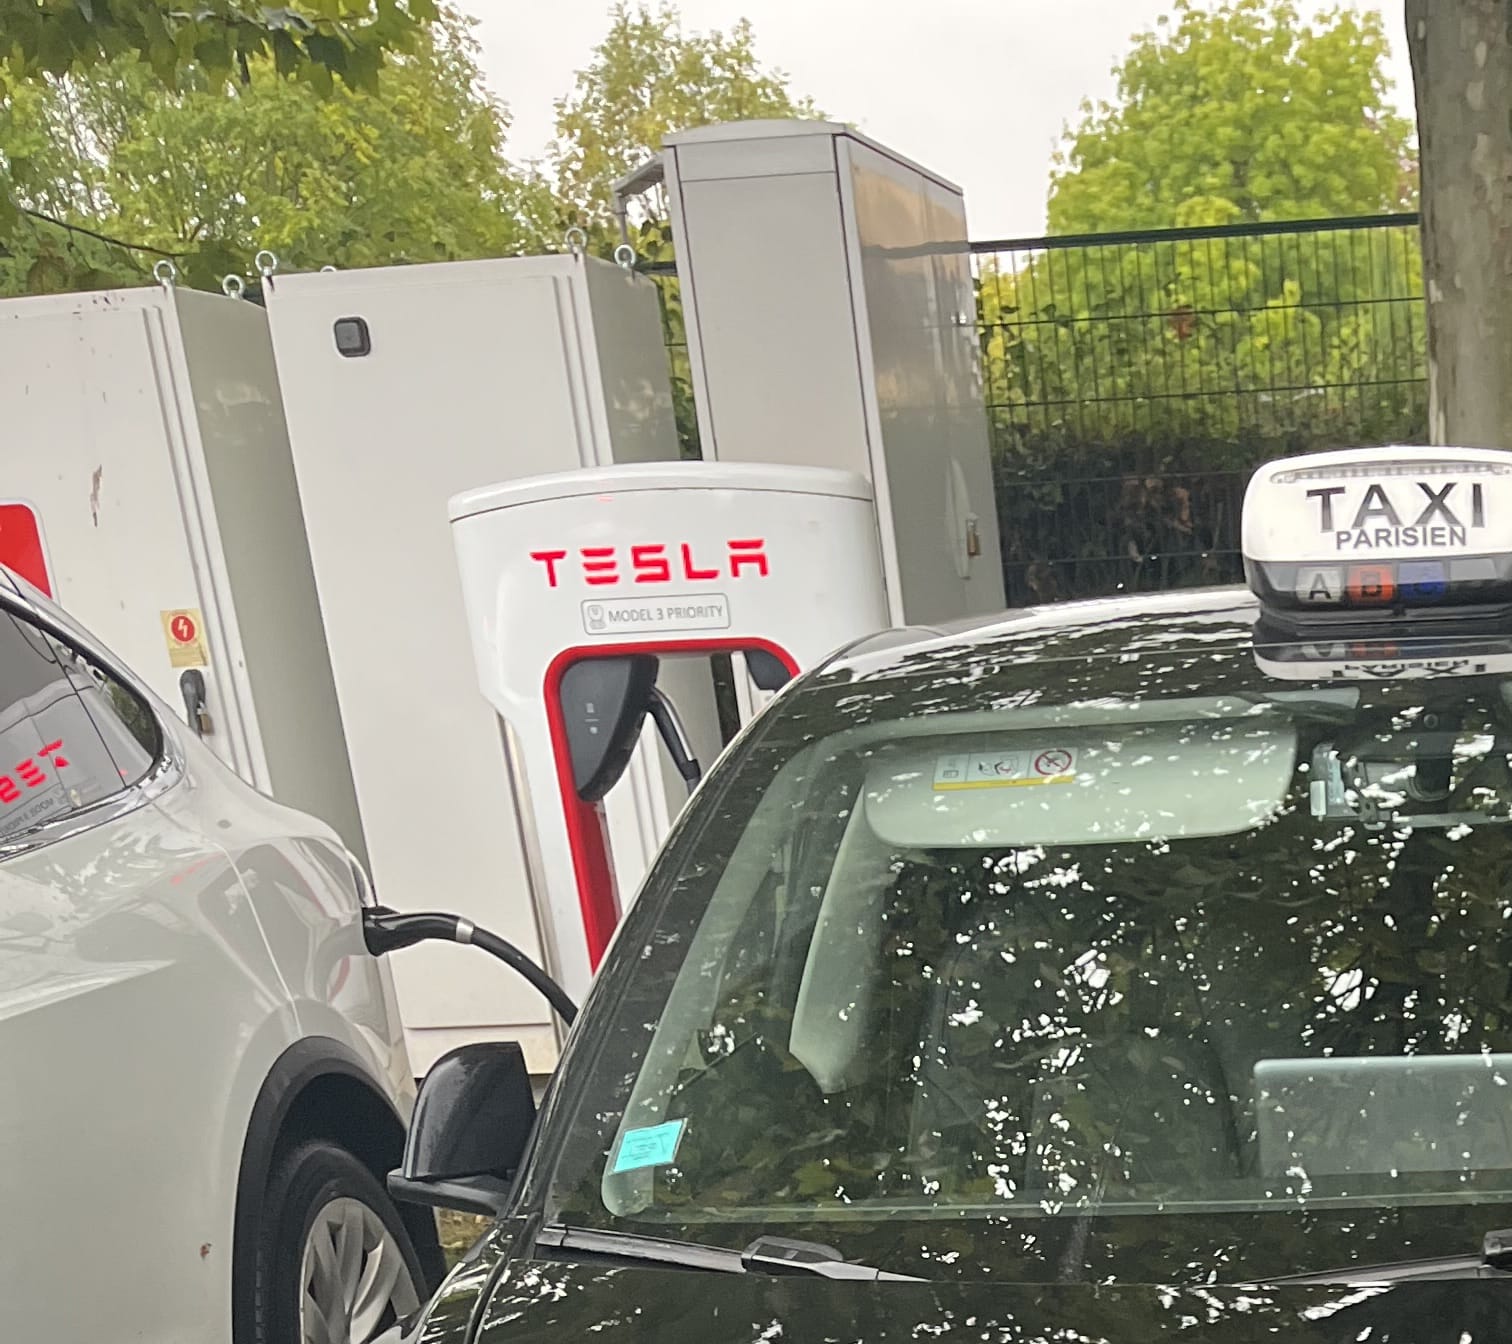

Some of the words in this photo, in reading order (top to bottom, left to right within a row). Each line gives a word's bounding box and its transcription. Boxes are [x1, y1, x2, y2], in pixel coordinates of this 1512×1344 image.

[1305, 481, 1486, 534] TAXI
[1335, 526, 1467, 550] PARISIEN
[529, 538, 769, 588] TESLA
[608, 607, 654, 623] MODEL
[656, 609, 665, 621] 3
[667, 604, 724, 620] PRIORITY
